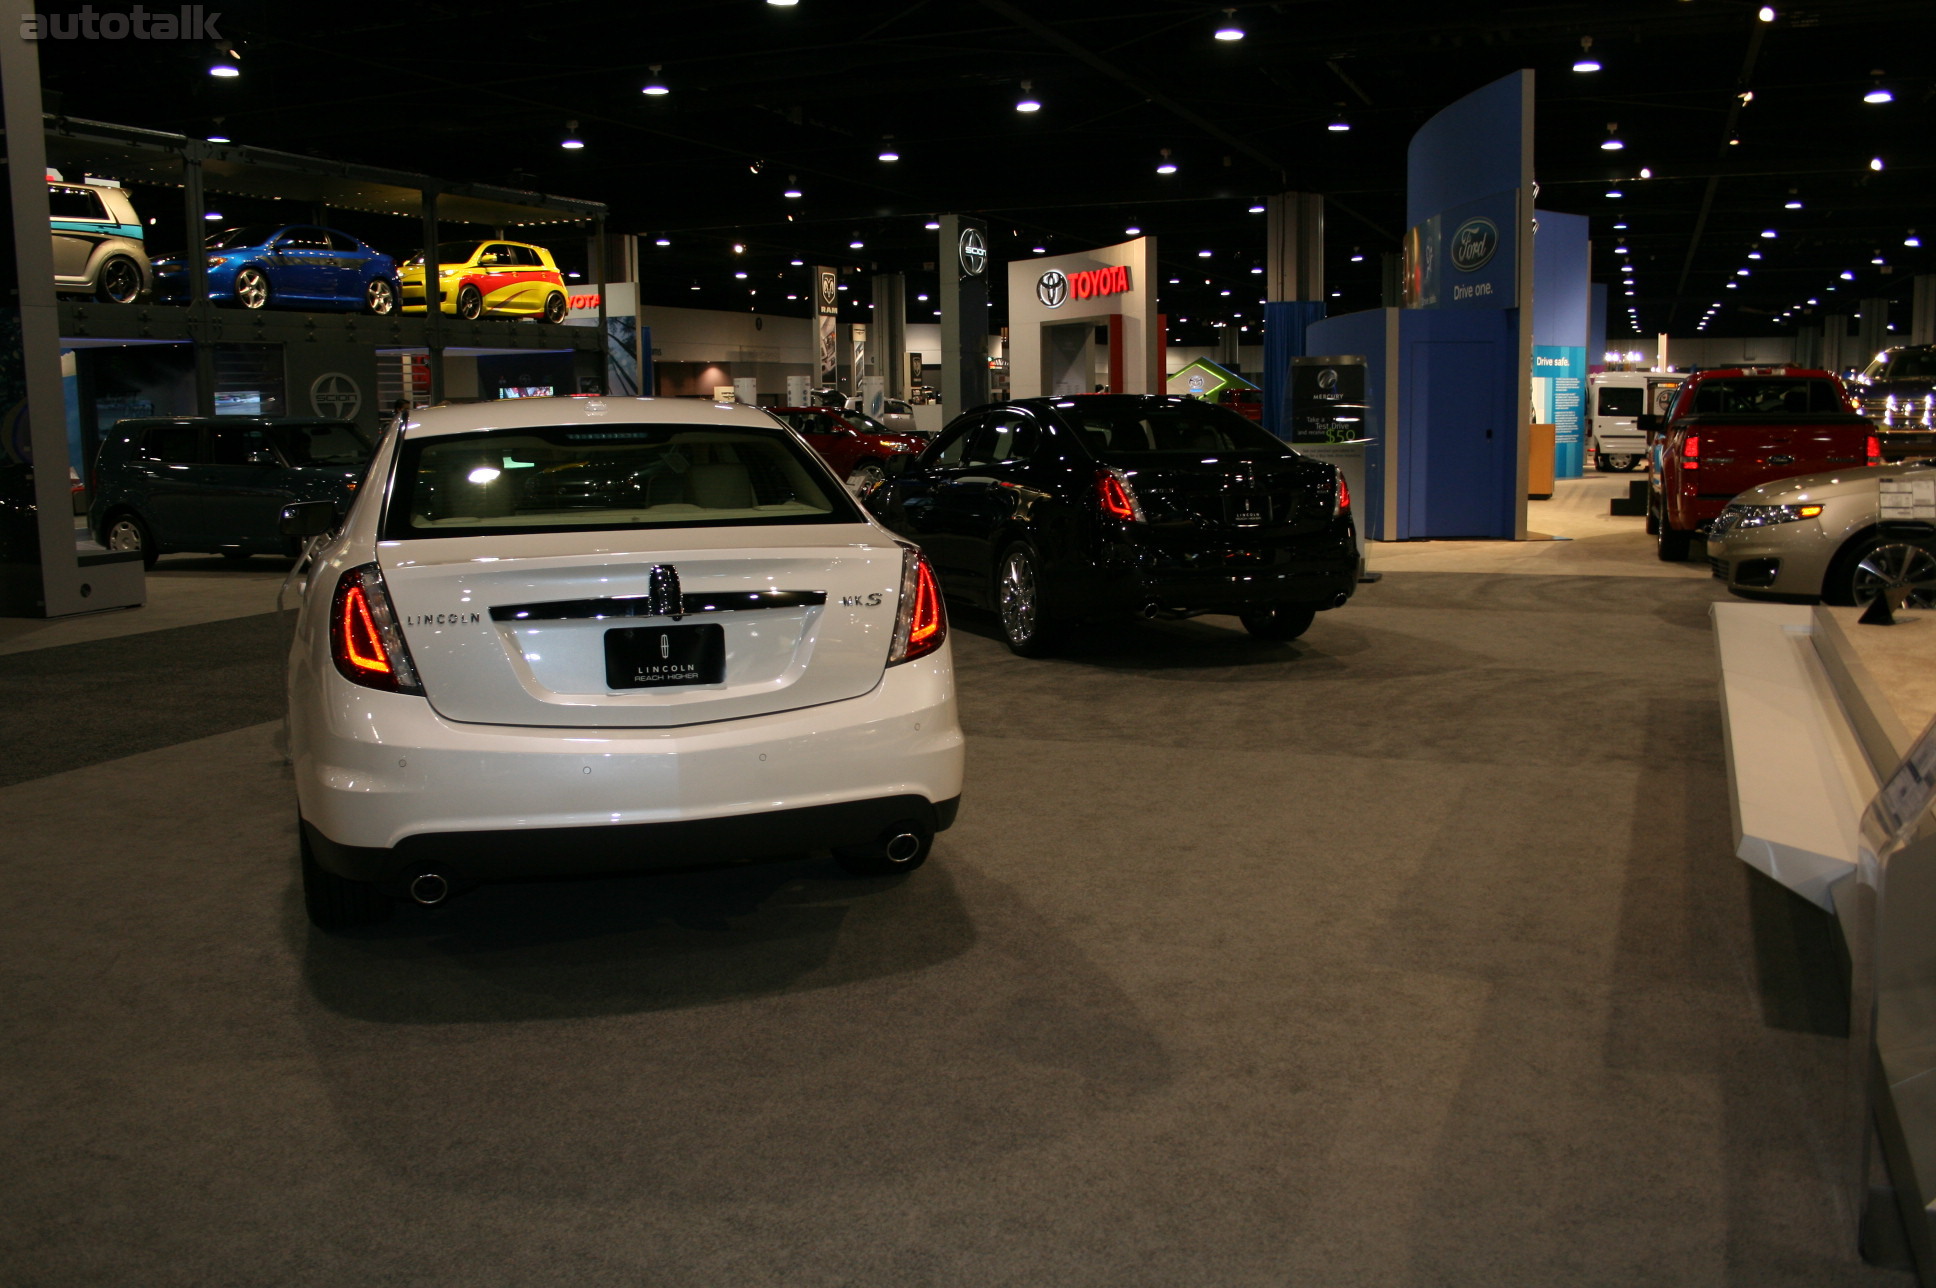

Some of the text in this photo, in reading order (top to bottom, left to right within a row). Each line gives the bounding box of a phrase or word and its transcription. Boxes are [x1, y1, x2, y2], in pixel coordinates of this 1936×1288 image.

[1459, 227, 1488, 262] Ford
[1067, 265, 1130, 299] TOYOTA
[1454, 283, 1493, 300] Drive one.
[568, 294, 602, 309] YOTA
[820, 306, 838, 314] RAM
[1536, 356, 1570, 366] Drive safe.
[1316, 422, 1350, 430] Test Drive
[1325, 427, 1356, 444] $50
[842, 592, 883, 607] MKS
[407, 612, 480, 626] LINCOLN
[638, 664, 695, 674] LINCOLN
[634, 672, 699, 682] REACH HIGHER
